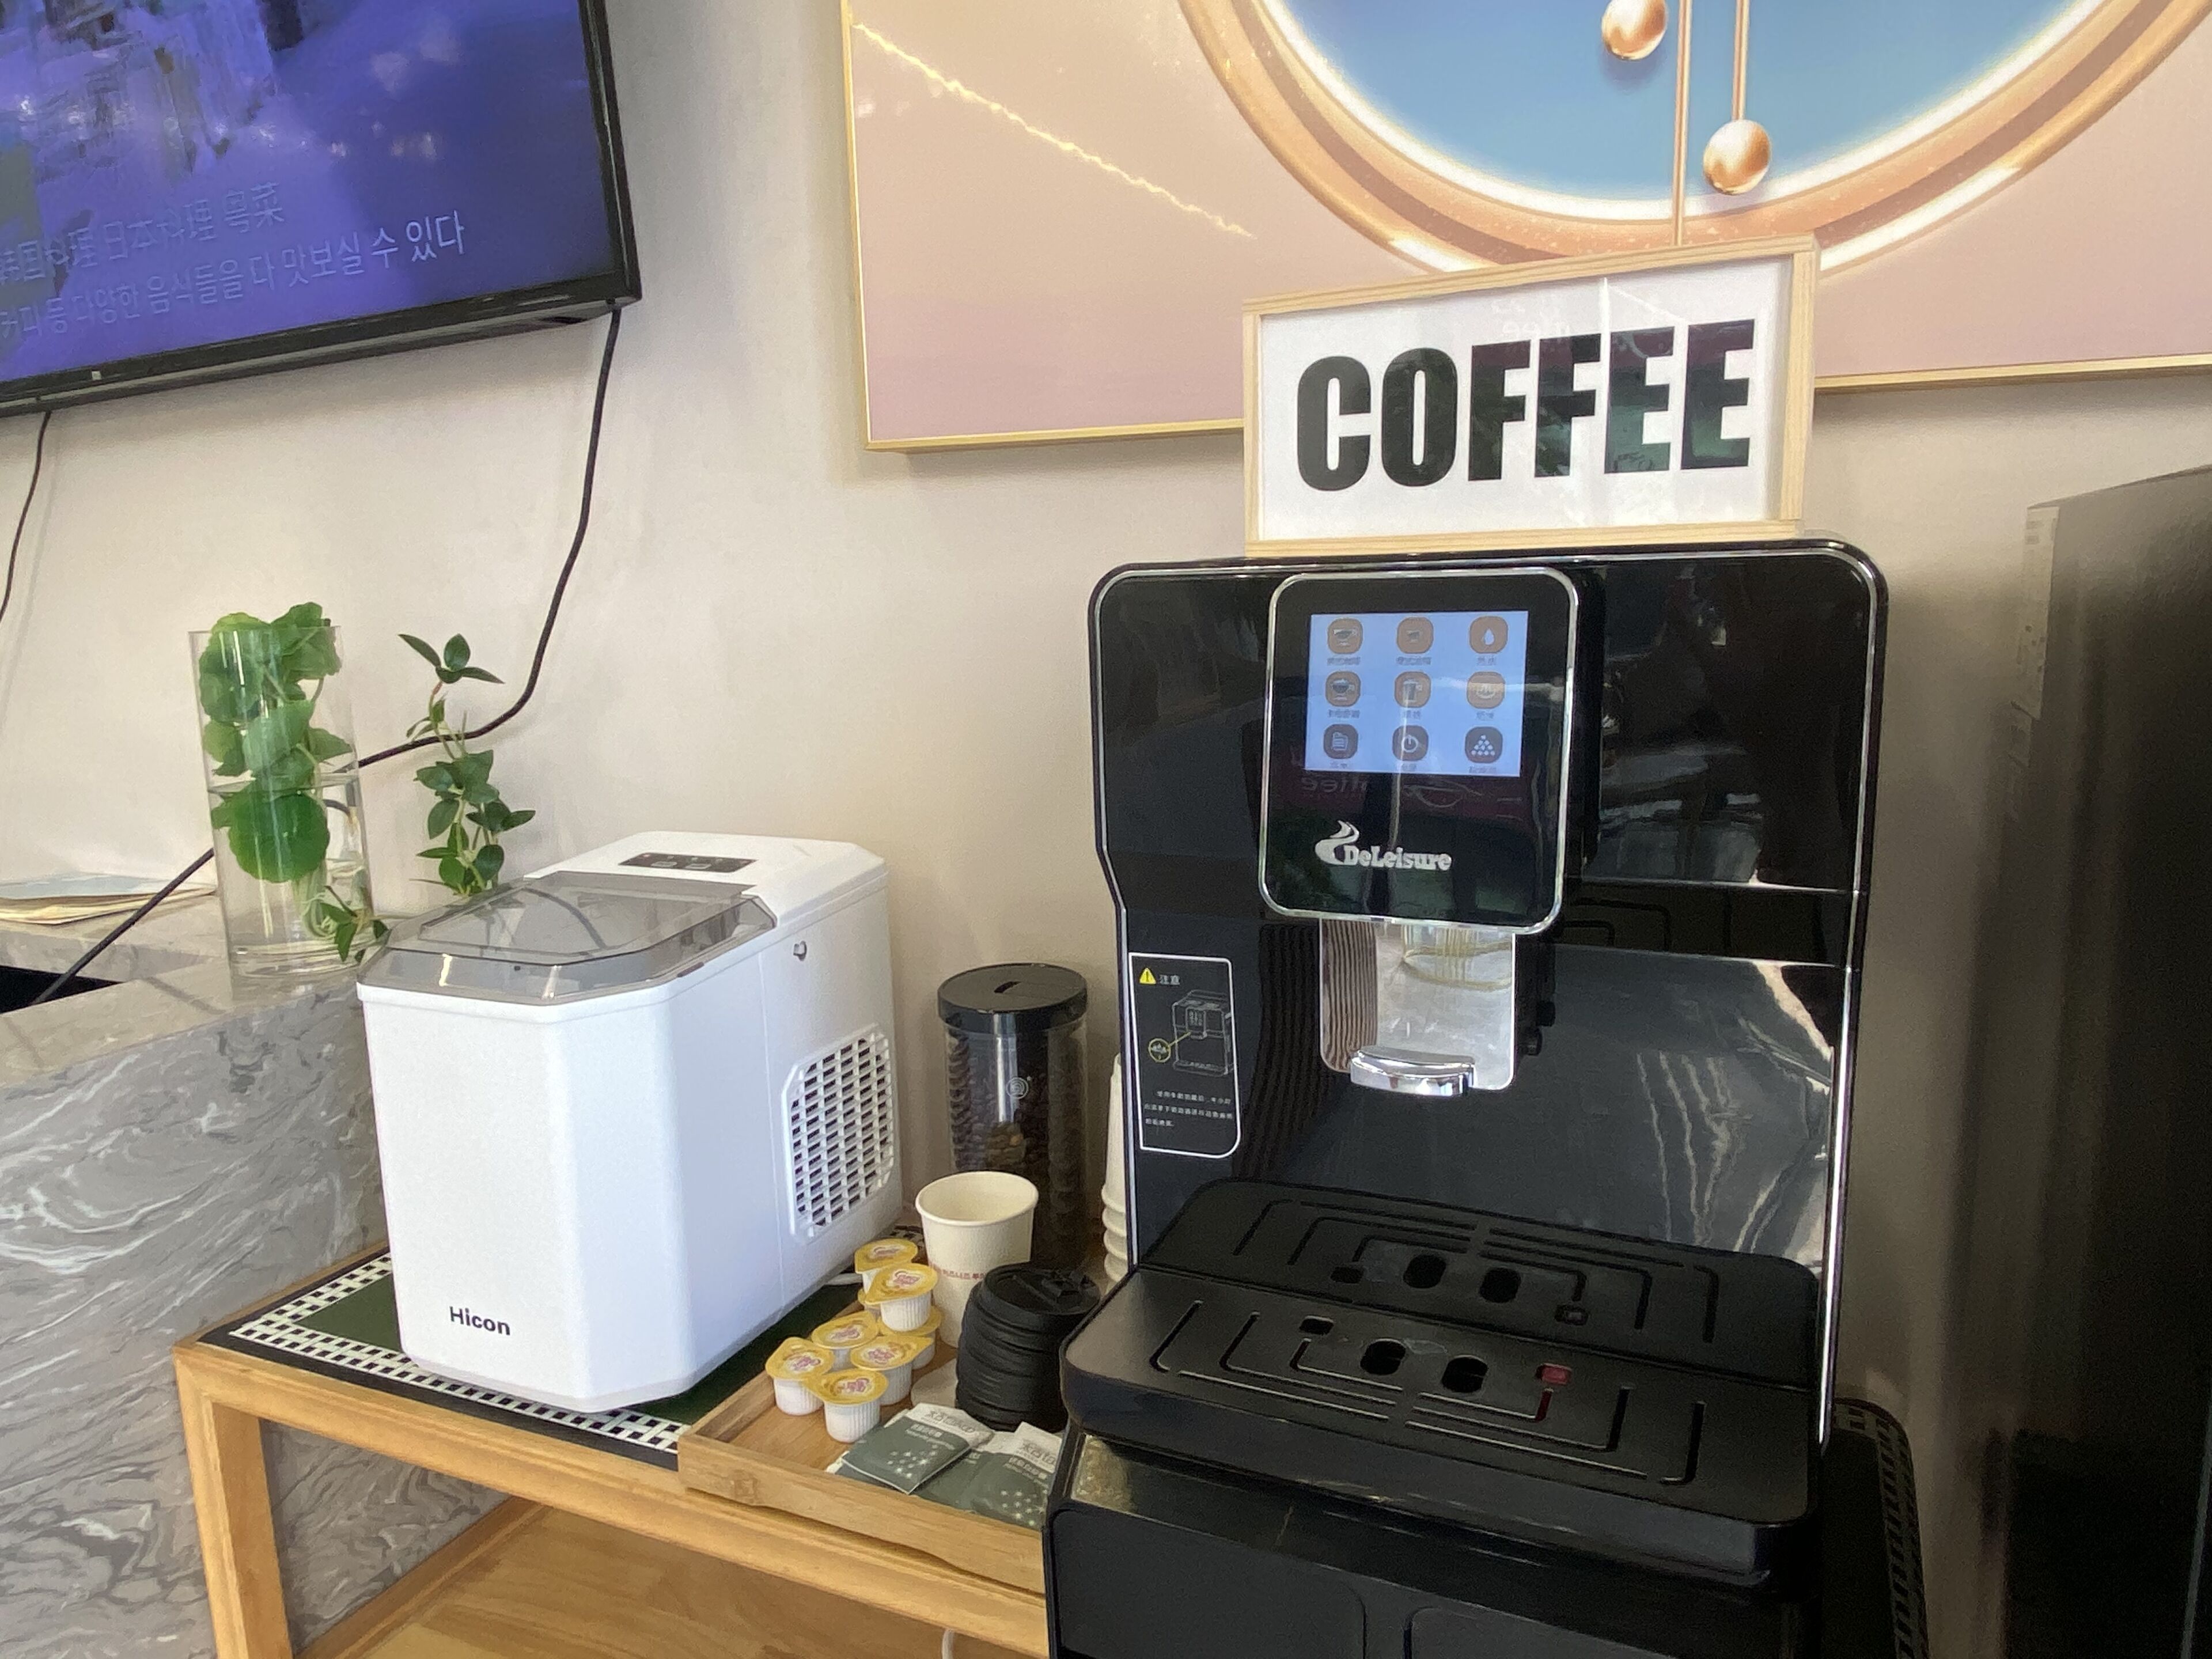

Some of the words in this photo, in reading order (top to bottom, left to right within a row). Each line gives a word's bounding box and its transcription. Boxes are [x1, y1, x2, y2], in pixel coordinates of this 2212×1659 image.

[281, 230, 365, 287] 맛보실
[369, 227, 399, 269] 수
[405, 209, 465, 262] 있다
[1297, 318, 1755, 491] COFFEE
[1342, 844, 1452, 872] DeLeisure
[449, 1305, 510, 1336] Hicon
